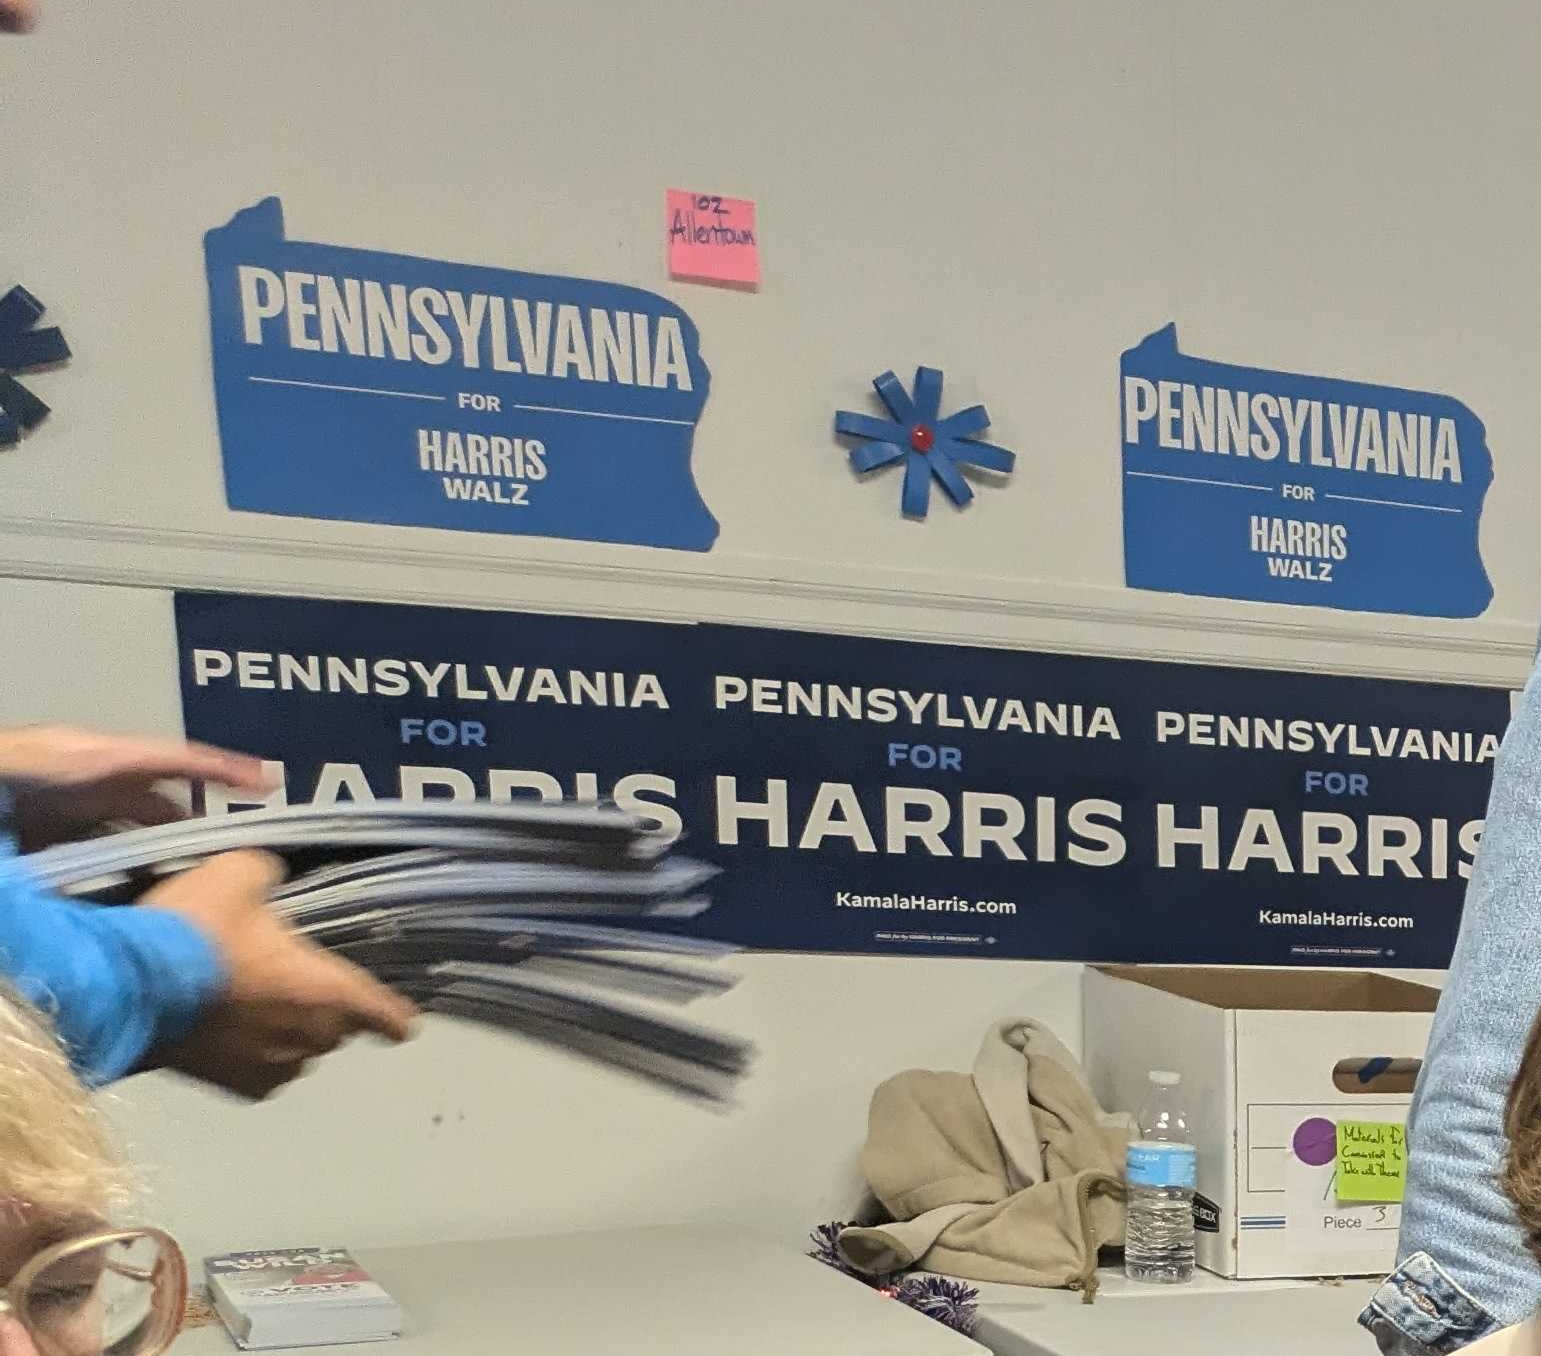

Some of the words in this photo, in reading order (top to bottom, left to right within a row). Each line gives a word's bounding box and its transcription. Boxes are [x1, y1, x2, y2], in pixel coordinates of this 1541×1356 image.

[239, 266, 693, 391] PENNSYLVANIA
[458, 392, 501, 412] FOR
[1124, 376, 1462, 483] PENNSYLVANIA
[419, 429, 546, 481] HARRIS
[444, 477, 529, 506] WALZ
[1282, 484, 1315, 501] FOR
[1251, 515, 1347, 560] HARRIS
[1268, 557, 1333, 582] WALZ
[193, 649, 670, 710] PENNSYLVANIA
[714, 675, 1121, 740] PENNSYLVANIA
[400, 718, 487, 748] FOR
[1157, 711, 1498, 764] PENNSYLVANIA
[888, 743, 963, 772] FOR
[1305, 771, 1368, 796] FOR
[715, 775, 1127, 867] HARRIS
[836, 892, 1017, 915] KamalaHarris.com
[1259, 909, 1414, 930] KamalaHarris.com
[1324, 1214, 1362, 1229] Piece
[1372, 1206, 1386, 1222] 3
